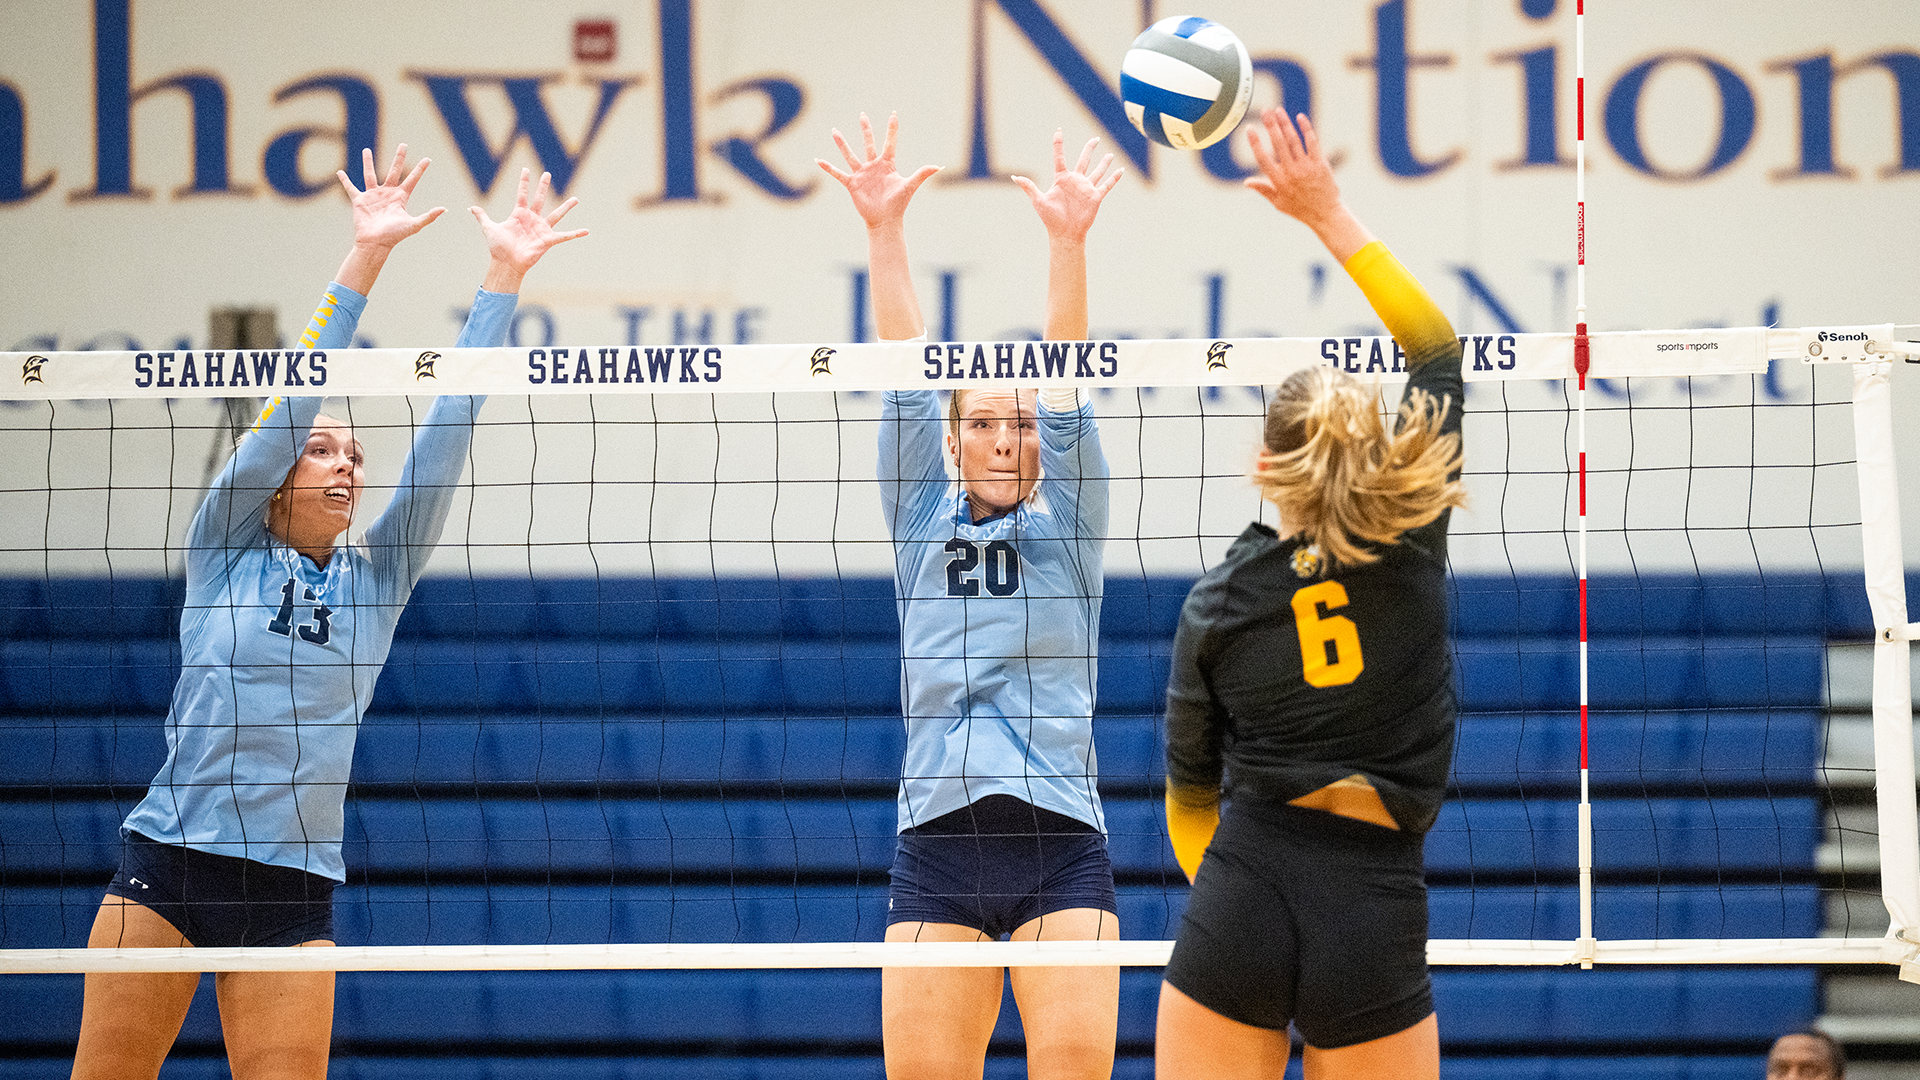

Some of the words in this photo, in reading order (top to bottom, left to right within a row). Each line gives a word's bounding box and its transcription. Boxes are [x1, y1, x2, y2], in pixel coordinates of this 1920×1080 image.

[1656, 343, 1684, 352] sports
[1685, 341, 1719, 352] imports
[1829, 331, 1869, 342] Senoh
[134, 351, 328, 389] SEAHAWKS
[528, 347, 722, 385] SEAHAWKS
[923, 341, 1119, 380] SEAHAWKS
[943, 536, 1020, 598] 20
[267, 577, 334, 646] 13
[1290, 580, 1364, 688] 6
